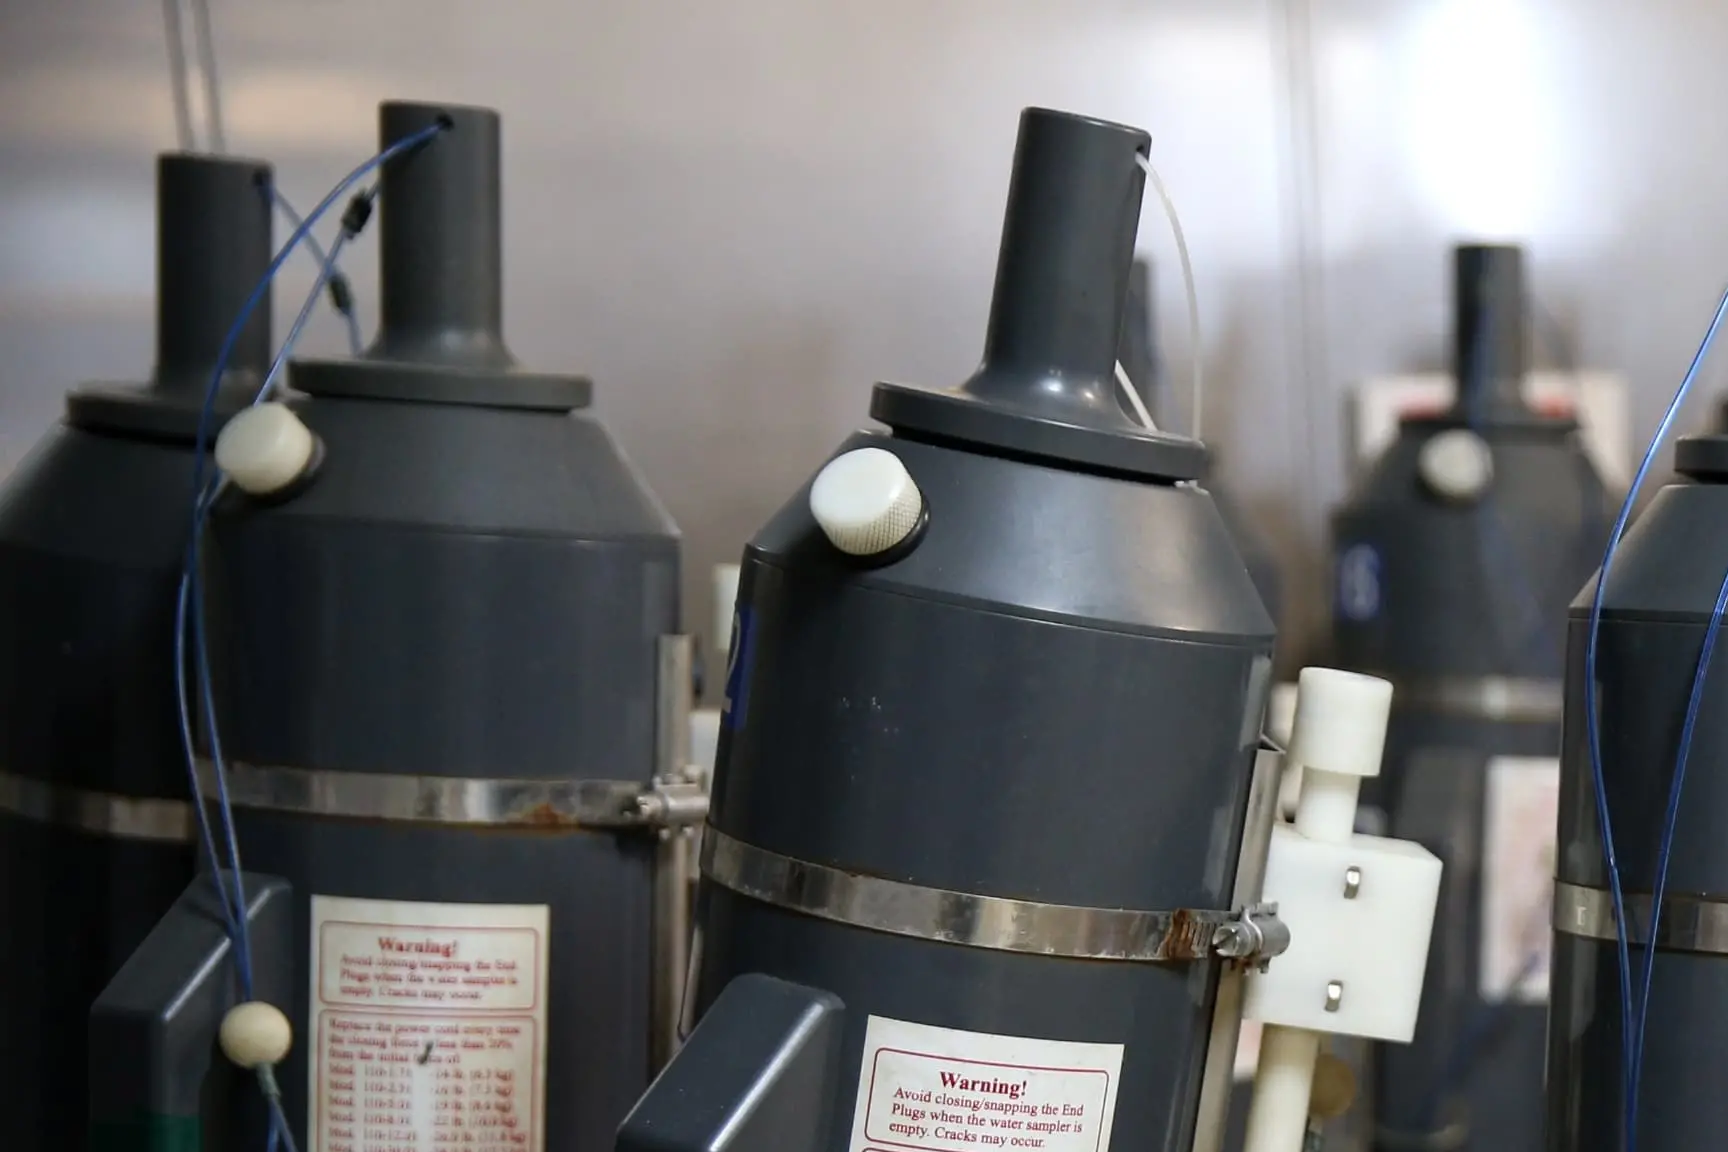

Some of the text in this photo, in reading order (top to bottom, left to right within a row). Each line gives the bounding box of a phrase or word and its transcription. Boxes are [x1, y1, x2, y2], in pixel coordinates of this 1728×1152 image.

[940, 1072, 1027, 1098] Warning!
[894, 1086, 1083, 1116] Avoid closing/snapping the End
[891, 1104, 1082, 1135] Plugs when the water sampler is
[889, 1122, 1045, 1148] empty. Cracks may occur.
